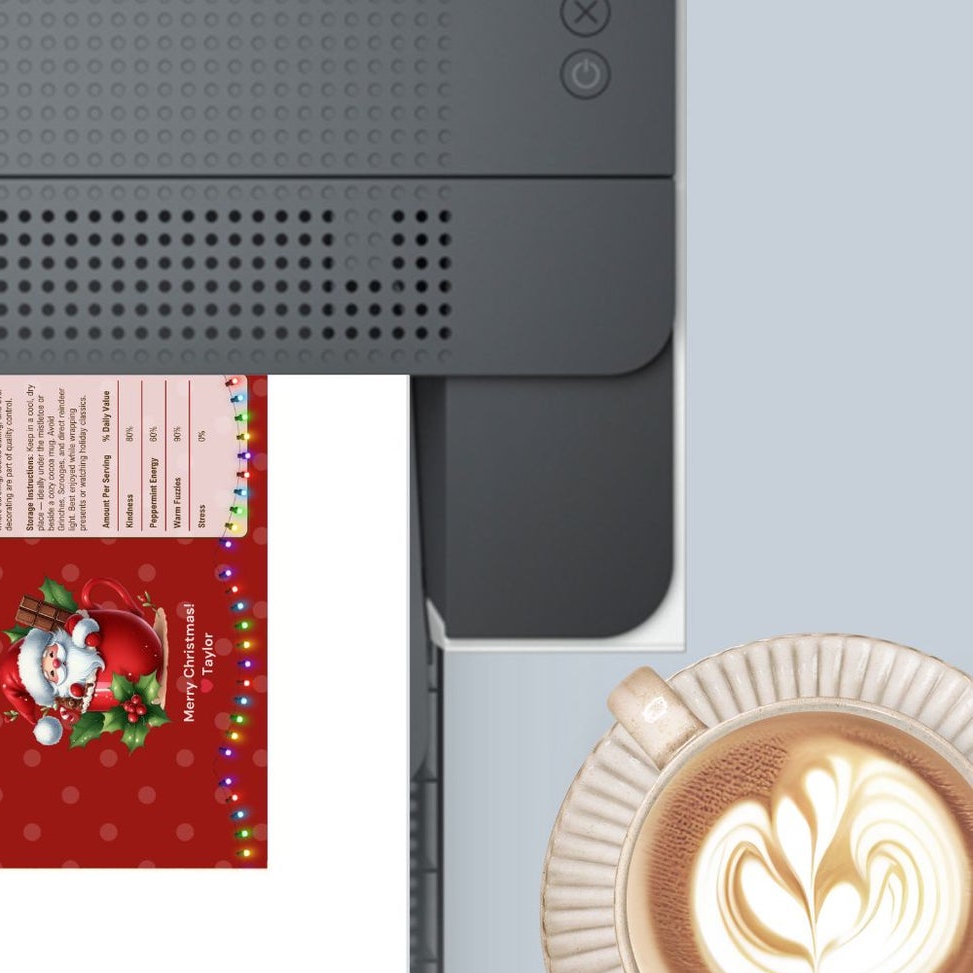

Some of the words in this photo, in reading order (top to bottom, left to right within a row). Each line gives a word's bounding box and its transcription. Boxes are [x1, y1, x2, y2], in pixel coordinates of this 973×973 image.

[26, 384, 35, 396] dry
[102, 391, 111, 412] Value
[47, 416, 55, 436] Avoid
[68, 408, 77, 442] wrapping
[102, 413, 111, 432] Daily
[5, 428, 13, 451] quality
[26, 434, 35, 452] Keep
[79, 428, 88, 453] holiday
[198, 431, 205, 442] 0%
[5, 462, 13, 477] part
[36, 453, 45, 475] under
[79, 456, 88, 488] watching
[102, 455, 111, 483] Serving
[150, 458, 158, 483] Energy
[26, 454, 35, 500] Instructions:
[36, 476, 45, 500] ideally
[68, 465, 77, 493] enjoyed
[47, 482, 55, 499] cozy
[80, 490, 86, 498] or
[5, 492, 13, 531] decorating
[26, 501, 35, 531] Storage
[79, 500, 88, 531] presents
[150, 485, 158, 528] Peppermint
[37, 512, 45, 531] place
[47, 508, 55, 531] beside
[183, 603, 195, 679] Christmas!
[201, 632, 217, 676] Taylor
[183, 682, 198, 722] Merry
